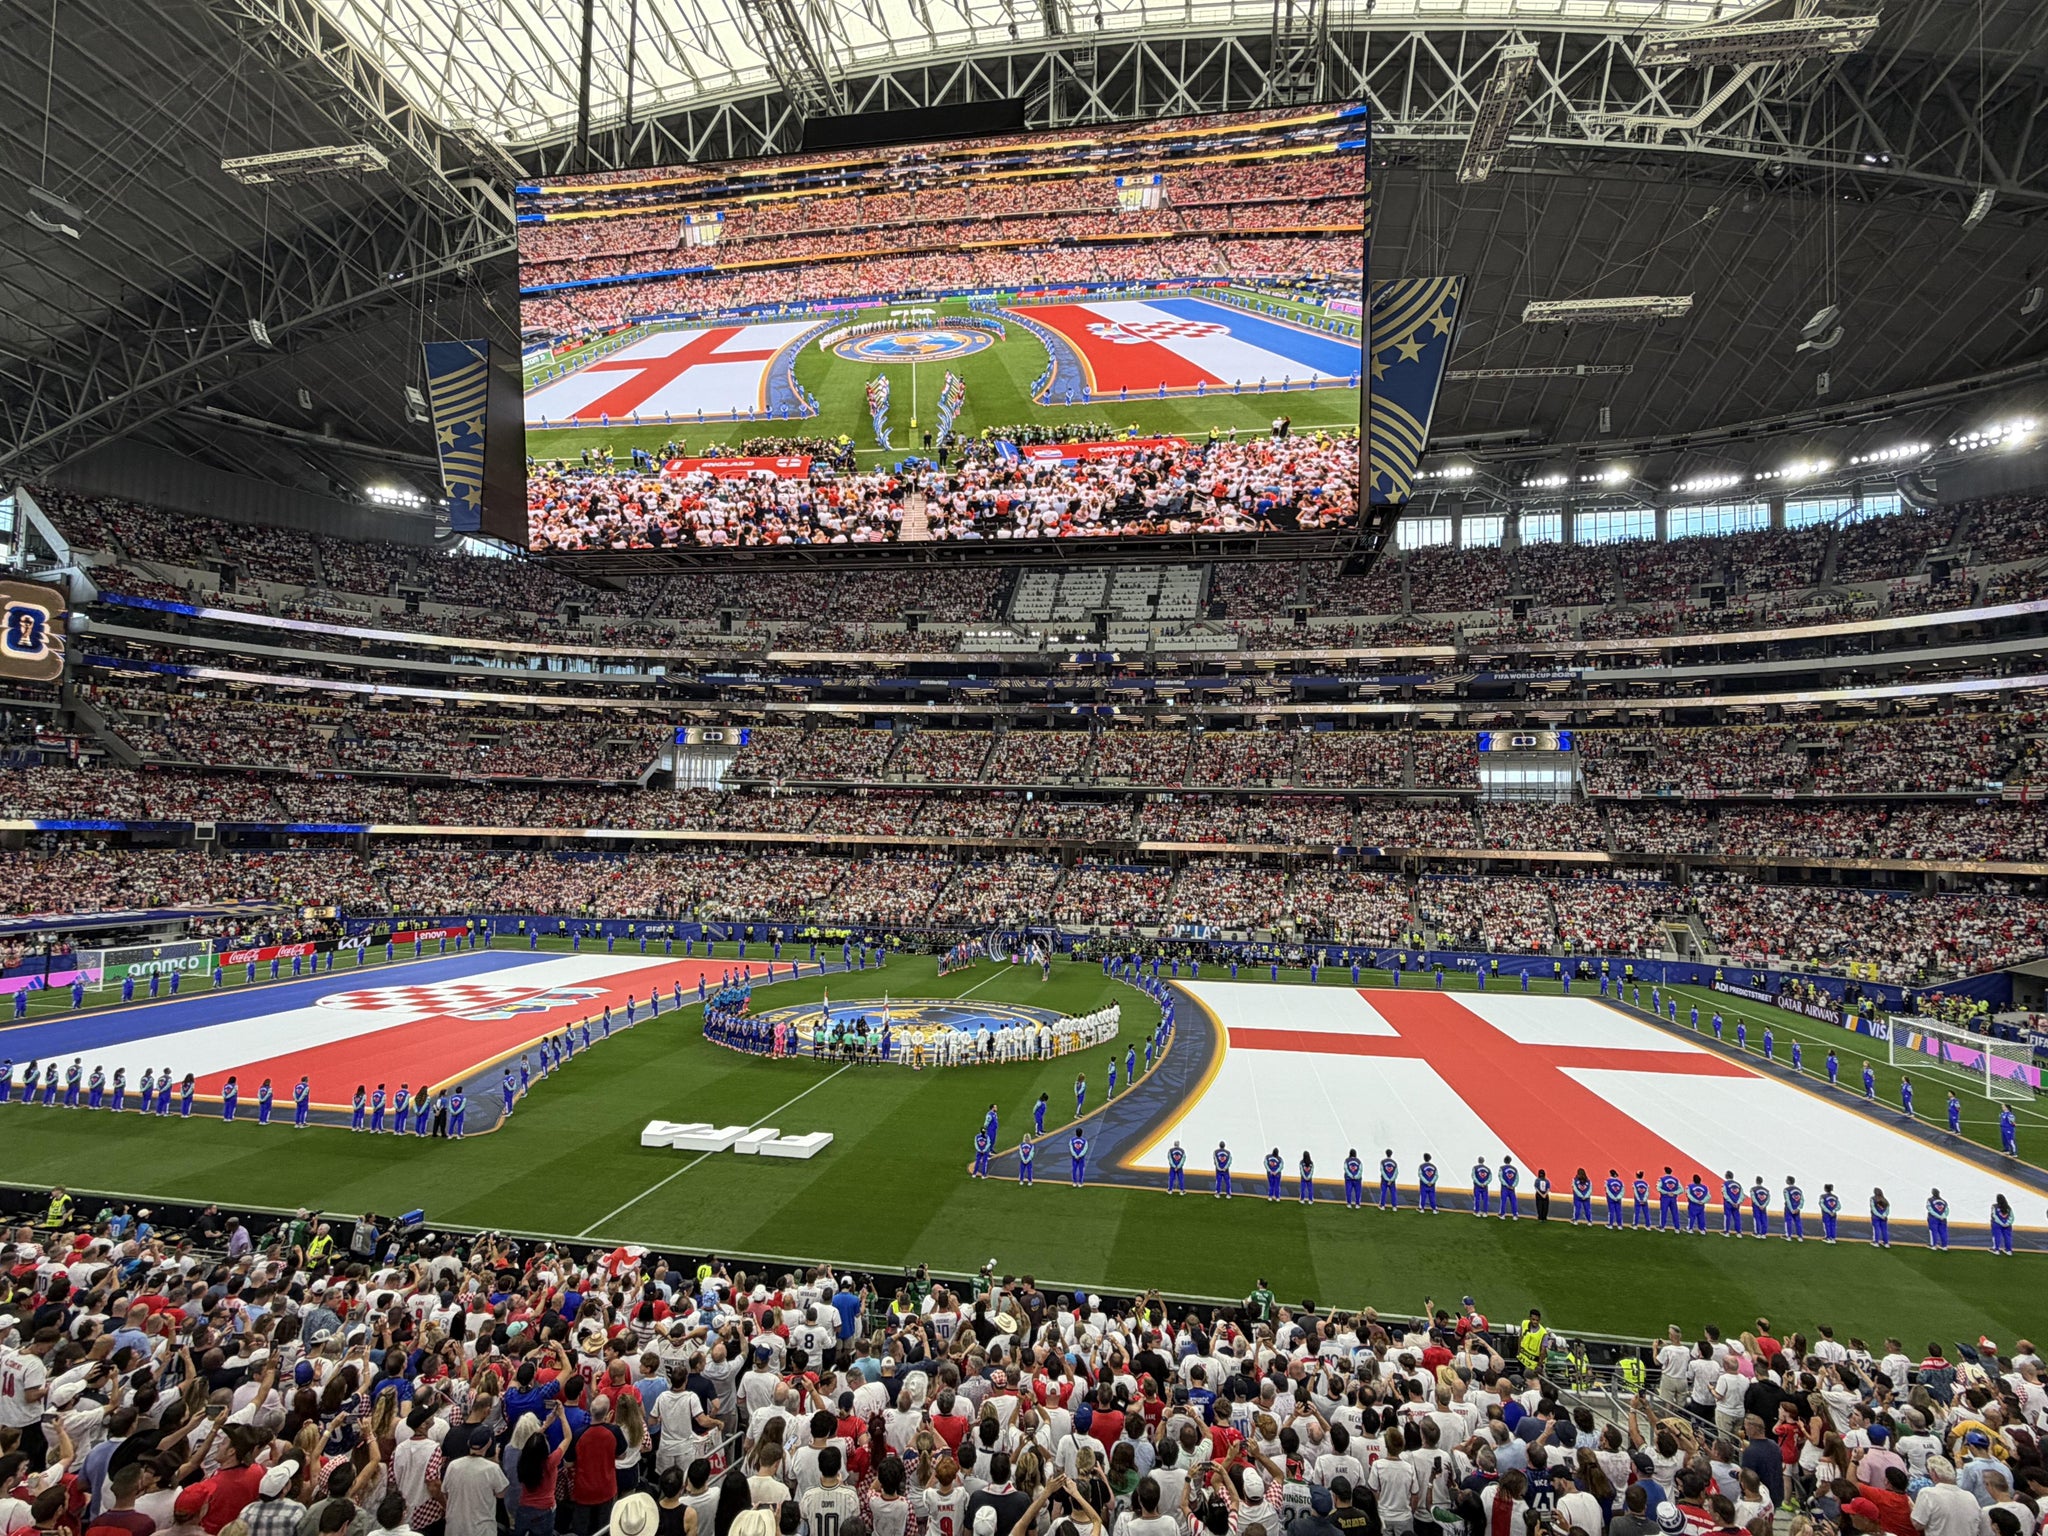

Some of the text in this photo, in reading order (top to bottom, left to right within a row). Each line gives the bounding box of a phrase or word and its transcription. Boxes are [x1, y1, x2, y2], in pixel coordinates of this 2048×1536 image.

[338, 934, 371, 950] KIA
[414, 929, 447, 940] Lenovo
[228, 947, 260, 963] Coca-Cola
[276, 943, 305, 958] Coca-Cola
[128, 957, 199, 977] aramco
[1714, 981, 1773, 1003] ADI PREDICTSTREET
[1777, 995, 1840, 1025] QATAR AIRWAYS
[803, 1333, 814, 1349] 8
[1856, 1358, 1871, 1374] 22
[1335, 1466, 1348, 1474] KANE
[1533, 1479, 1547, 1487] RICE
[937, 1504, 955, 1512] KANE
[1531, 1492, 1554, 1512] 41
[815, 1512, 839, 1536] 10
